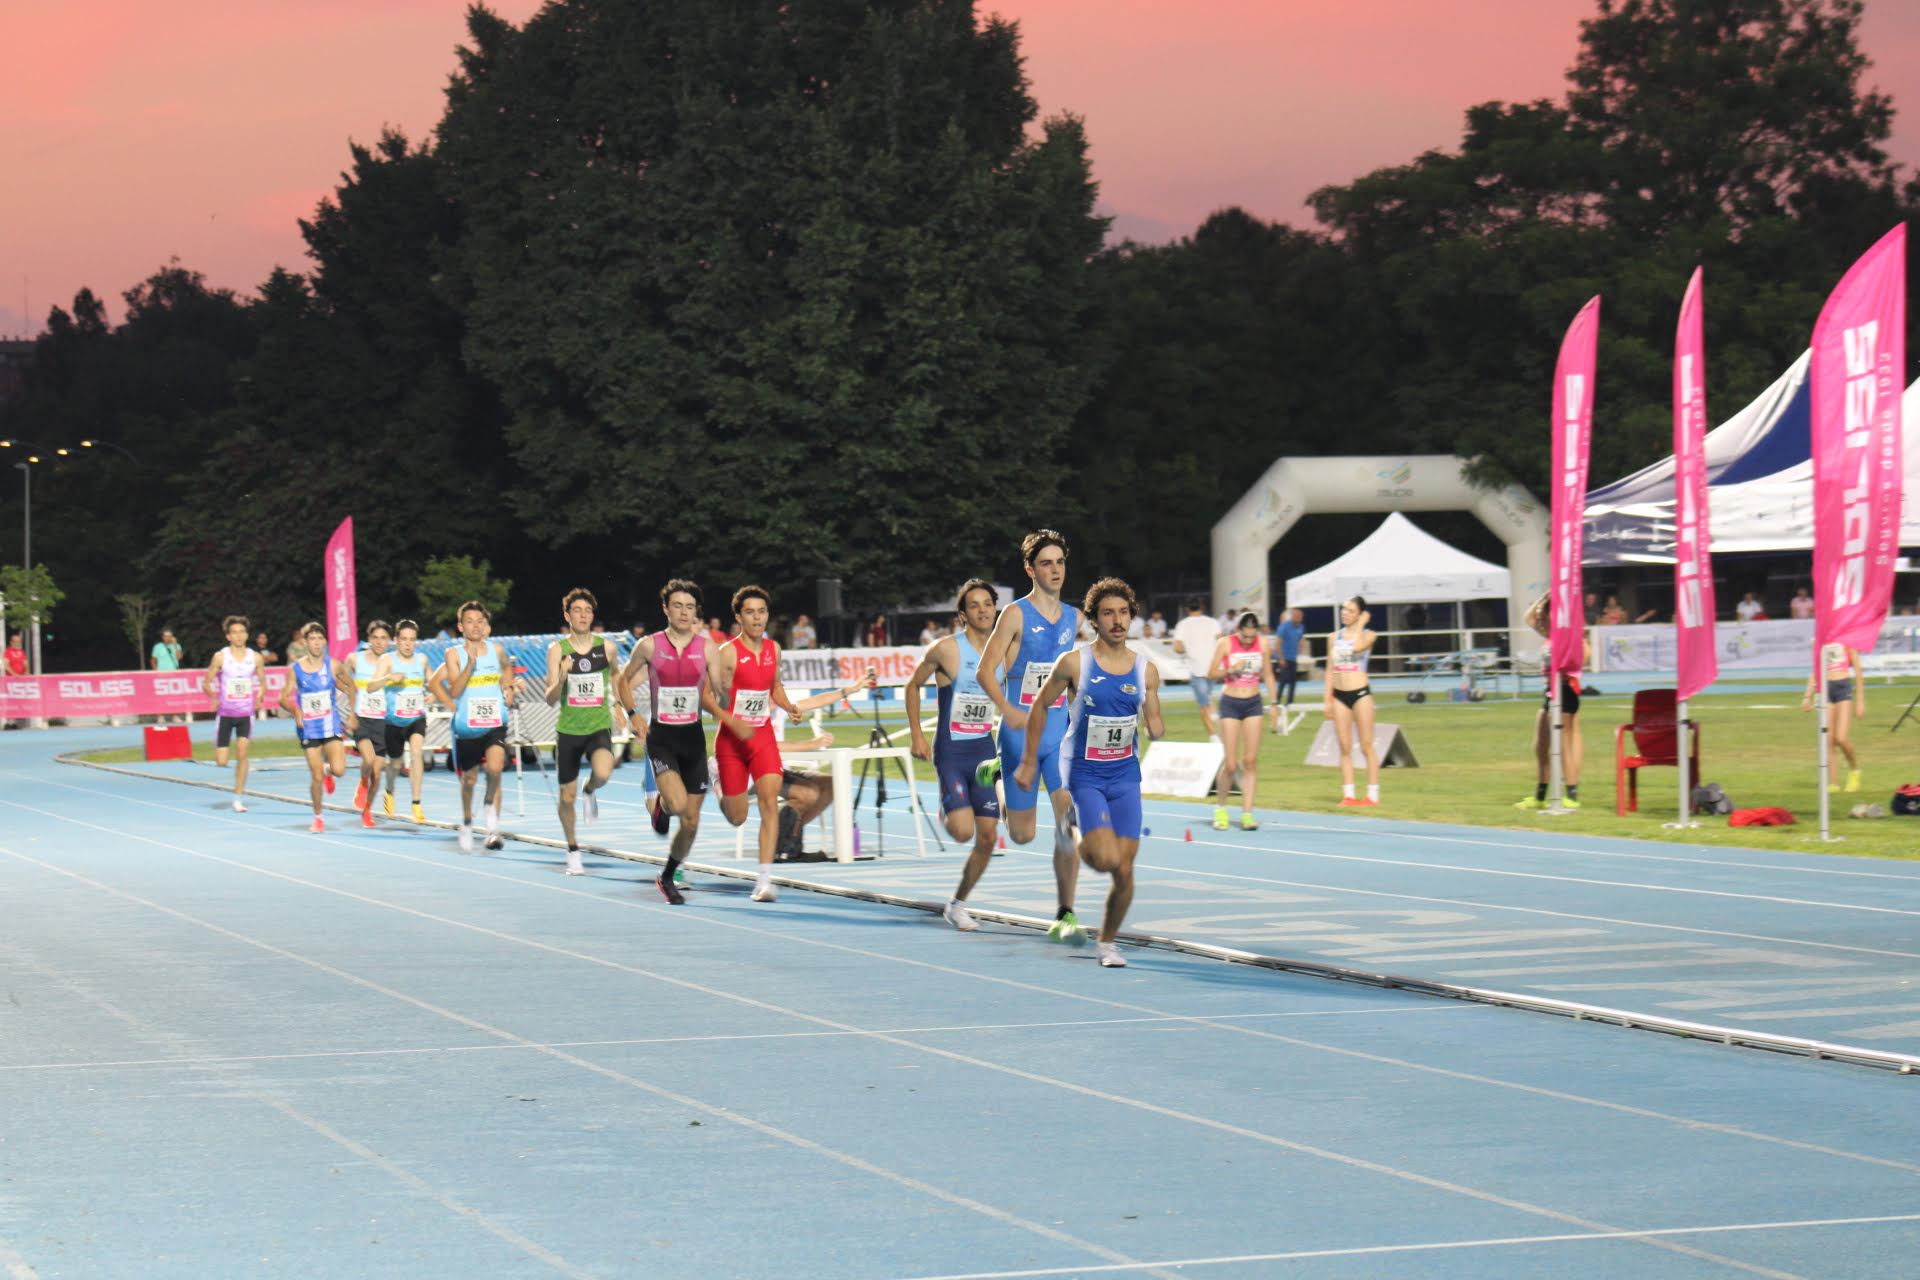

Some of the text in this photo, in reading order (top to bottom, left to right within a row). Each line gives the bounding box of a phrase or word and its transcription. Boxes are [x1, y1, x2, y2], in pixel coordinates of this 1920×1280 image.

[1833, 320, 1878, 610] SOLISS
[59, 678, 135, 699] SOLISS
[577, 682, 595, 694] 182
[672, 696, 687, 709] 42
[744, 699, 764, 712] 228
[963, 704, 986, 719] 340
[1107, 728, 1122, 743] 14
